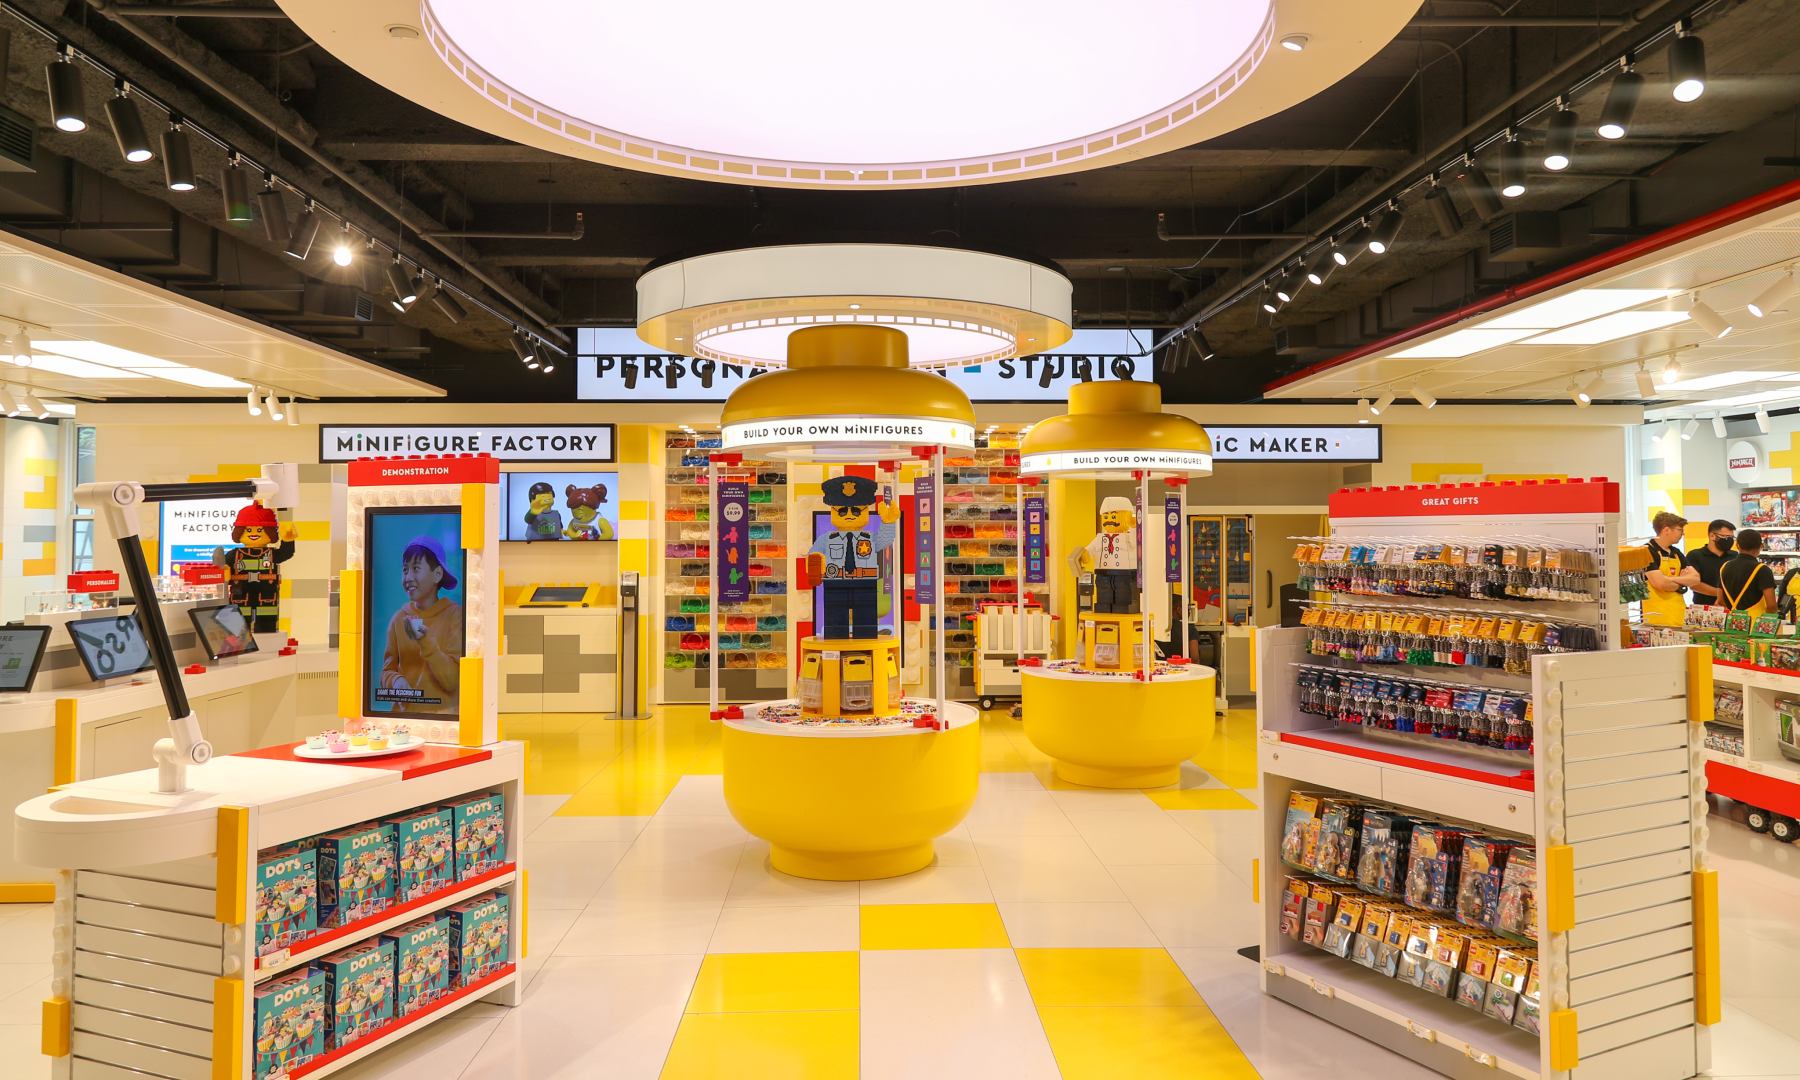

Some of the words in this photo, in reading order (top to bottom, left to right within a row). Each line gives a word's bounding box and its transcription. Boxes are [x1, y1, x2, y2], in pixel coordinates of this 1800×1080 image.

[998, 356, 1135, 379] STUDIO
[744, 428, 769, 439] BUILD
[773, 426, 803, 436] YOUR
[808, 425, 839, 435] OWN
[491, 435, 598, 451] FACTORY
[1250, 437, 1328, 453] MAKER
[382, 467, 449, 477] DEMONSTRATION
[1421, 497, 1450, 506] GREAT
[1452, 496, 1479, 505] GIFTS
[174, 510, 236, 518] MiNIFIGUR
[182, 524, 235, 532] FACTORY
[466, 800, 493, 817] DOTS
[412, 815, 440, 833] DOTS
[352, 831, 382, 850] DOTS
[265, 857, 301, 879] DOTS
[474, 902, 499, 921] DOTS
[449, 918, 461, 926] OTS
[411, 925, 438, 946] DOTS
[350, 951, 381, 973] DOTS
[274, 982, 310, 1007] DOTS
